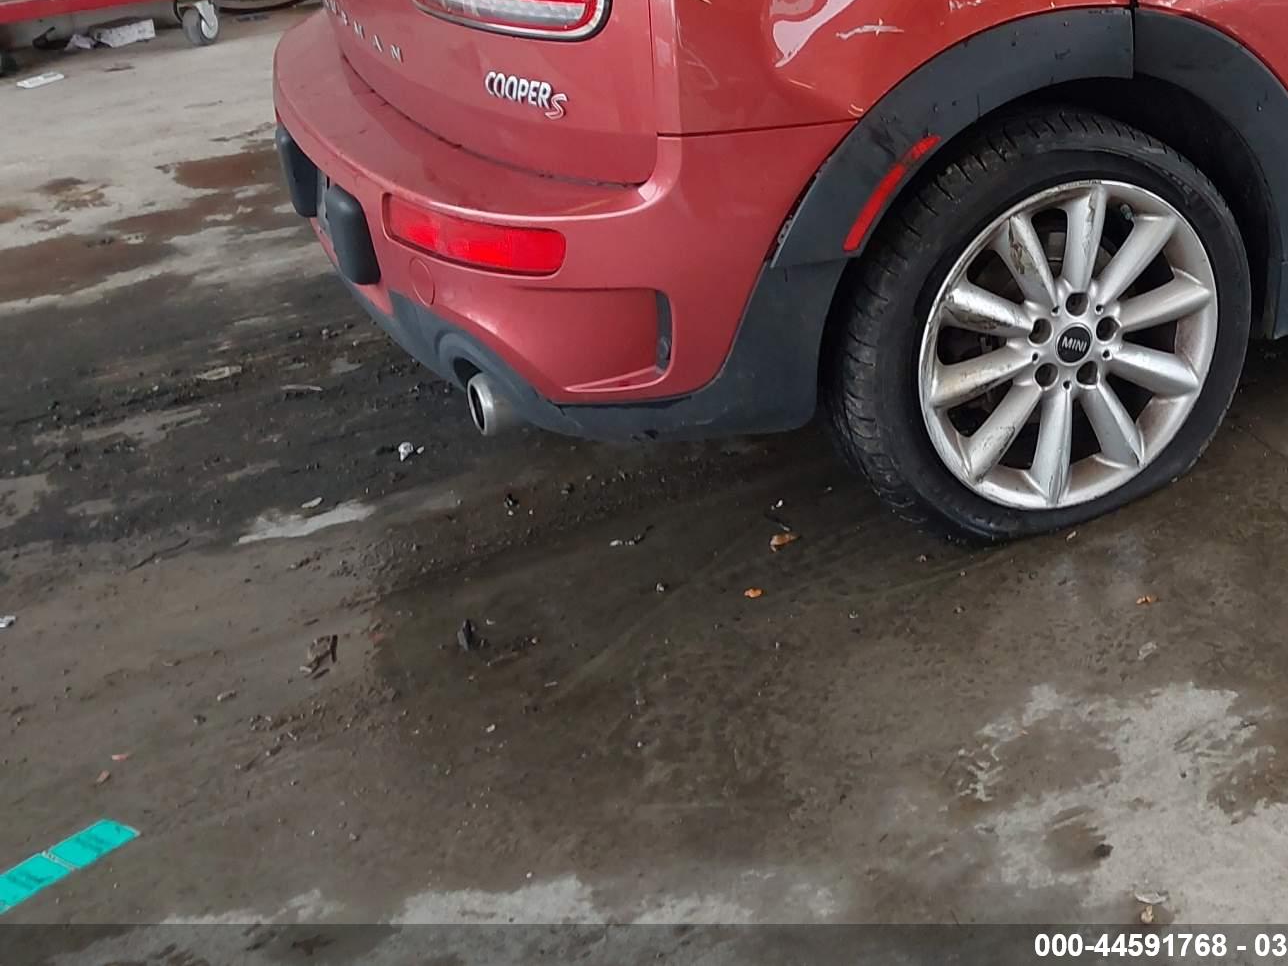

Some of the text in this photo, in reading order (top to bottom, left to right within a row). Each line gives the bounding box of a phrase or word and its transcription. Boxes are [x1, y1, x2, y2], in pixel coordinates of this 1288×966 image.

[485, 71, 568, 120] COOPER S
[1061, 336, 1088, 353] MINI
